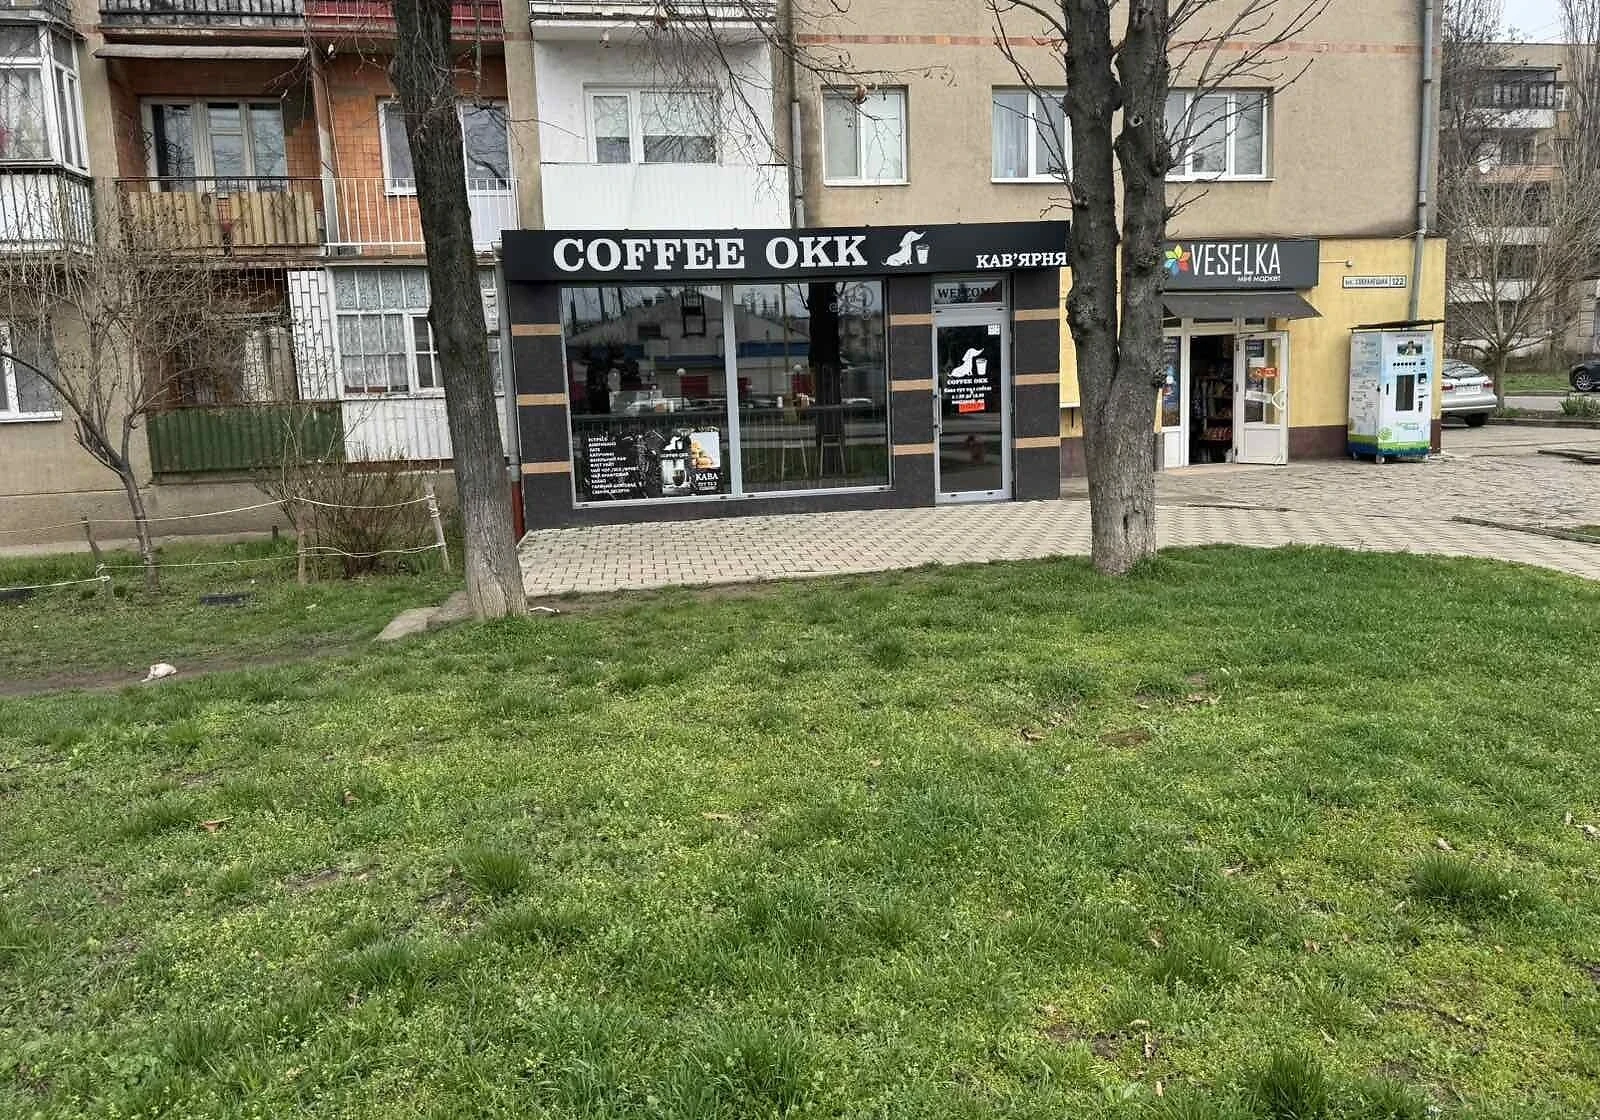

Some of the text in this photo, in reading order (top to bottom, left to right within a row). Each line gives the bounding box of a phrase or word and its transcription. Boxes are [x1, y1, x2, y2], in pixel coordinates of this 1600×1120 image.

[553, 235, 868, 272] COFFEE OKK
[975, 251, 1068, 269] КАВ’ЯРНЯ
[1191, 243, 1281, 276] VESELKA
